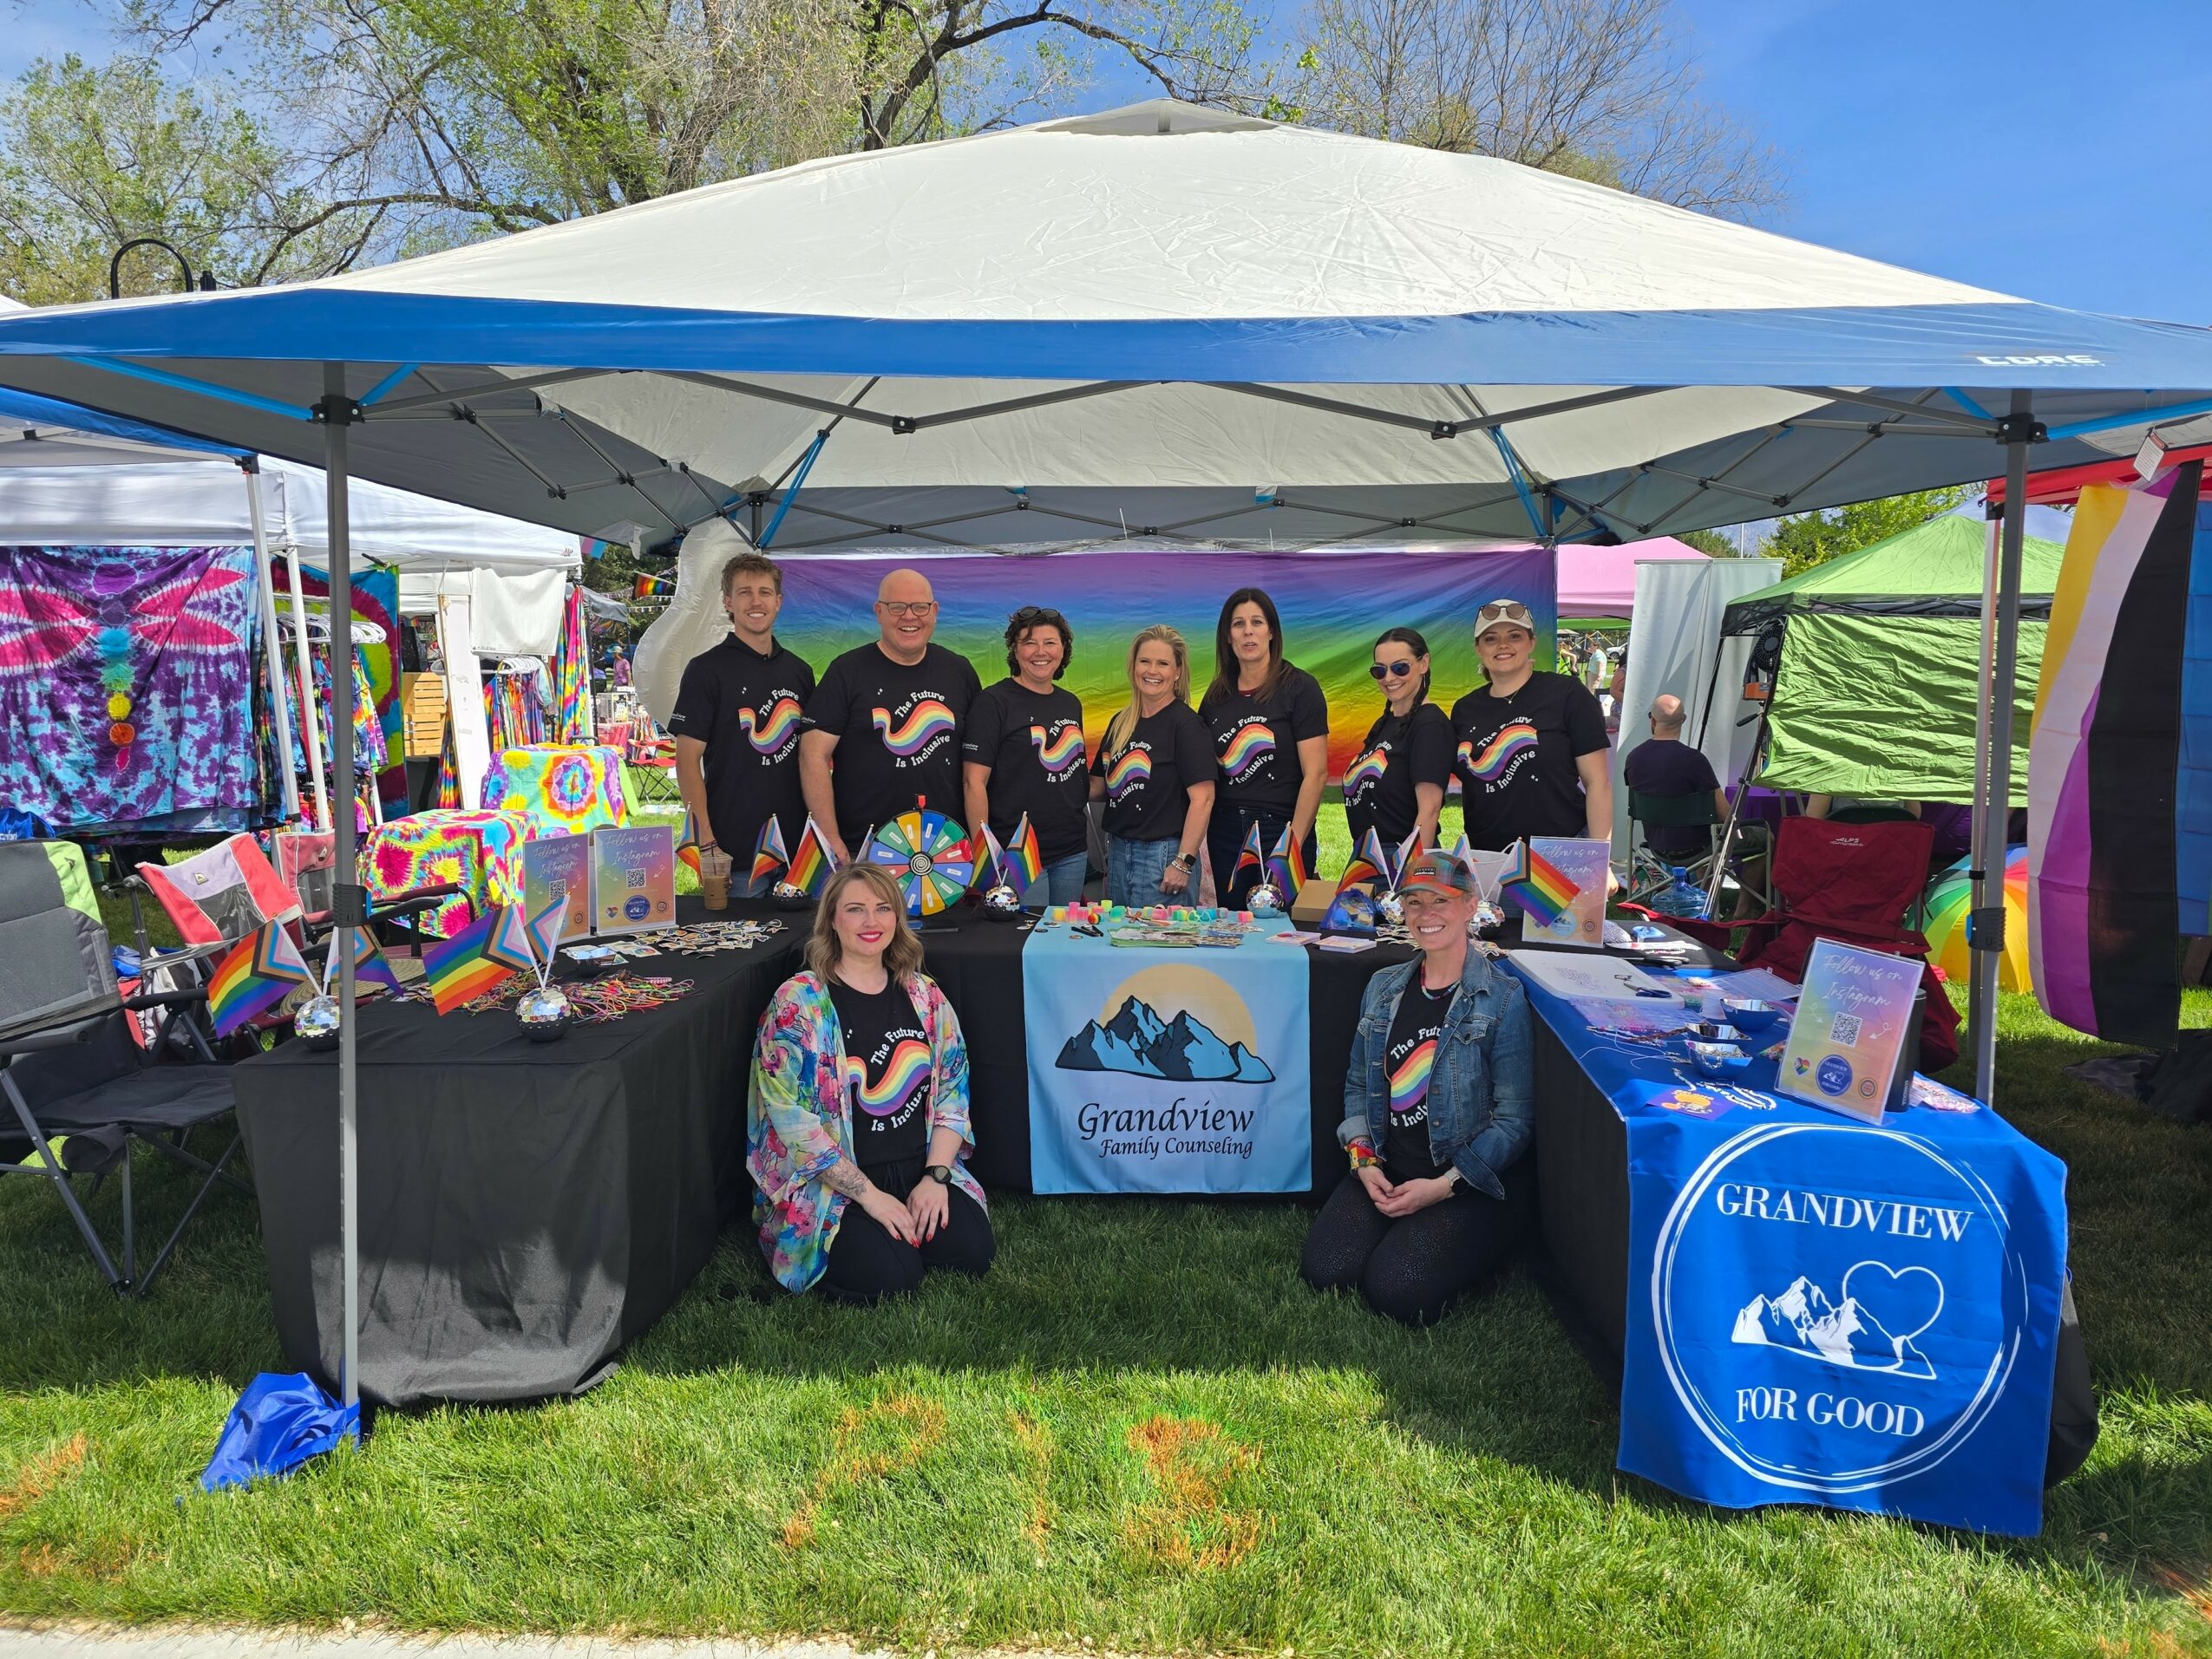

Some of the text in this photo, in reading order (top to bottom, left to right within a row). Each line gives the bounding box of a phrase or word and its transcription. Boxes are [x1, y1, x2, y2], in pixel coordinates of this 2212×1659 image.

[1976, 355, 2101, 365] CORE
[758, 688, 800, 716] The Future
[894, 689, 946, 719] The Future
[1218, 715, 1268, 743] The Future
[1476, 731, 1498, 748] The
[761, 755, 771, 766] Is
[895, 735, 951, 767] Is Inclusive
[1046, 773, 1057, 782] Is
[1234, 754, 1274, 784] Inclusive
[1485, 750, 1536, 793] Is Inclusive
[533, 845, 560, 860] Follow
[605, 832, 637, 846] Follow
[639, 833, 649, 842] us
[1541, 845, 1572, 859] Follow
[1574, 849, 1584, 858] us
[612, 849, 662, 866] Instagram
[1823, 954, 1903, 981] Follow us on
[1823, 982, 1892, 1012] Instagram
[870, 1027, 926, 1066] The Future
[1390, 1038, 1415, 1060] The
[871, 1119, 885, 1132] Is
[1077, 1097, 1254, 1140] Grandview
[1099, 1135, 1253, 1160] Family Counseling
[1716, 1182, 1974, 1242] GRANDVIEW
[1736, 1386, 1925, 1437] FOR GOOD
